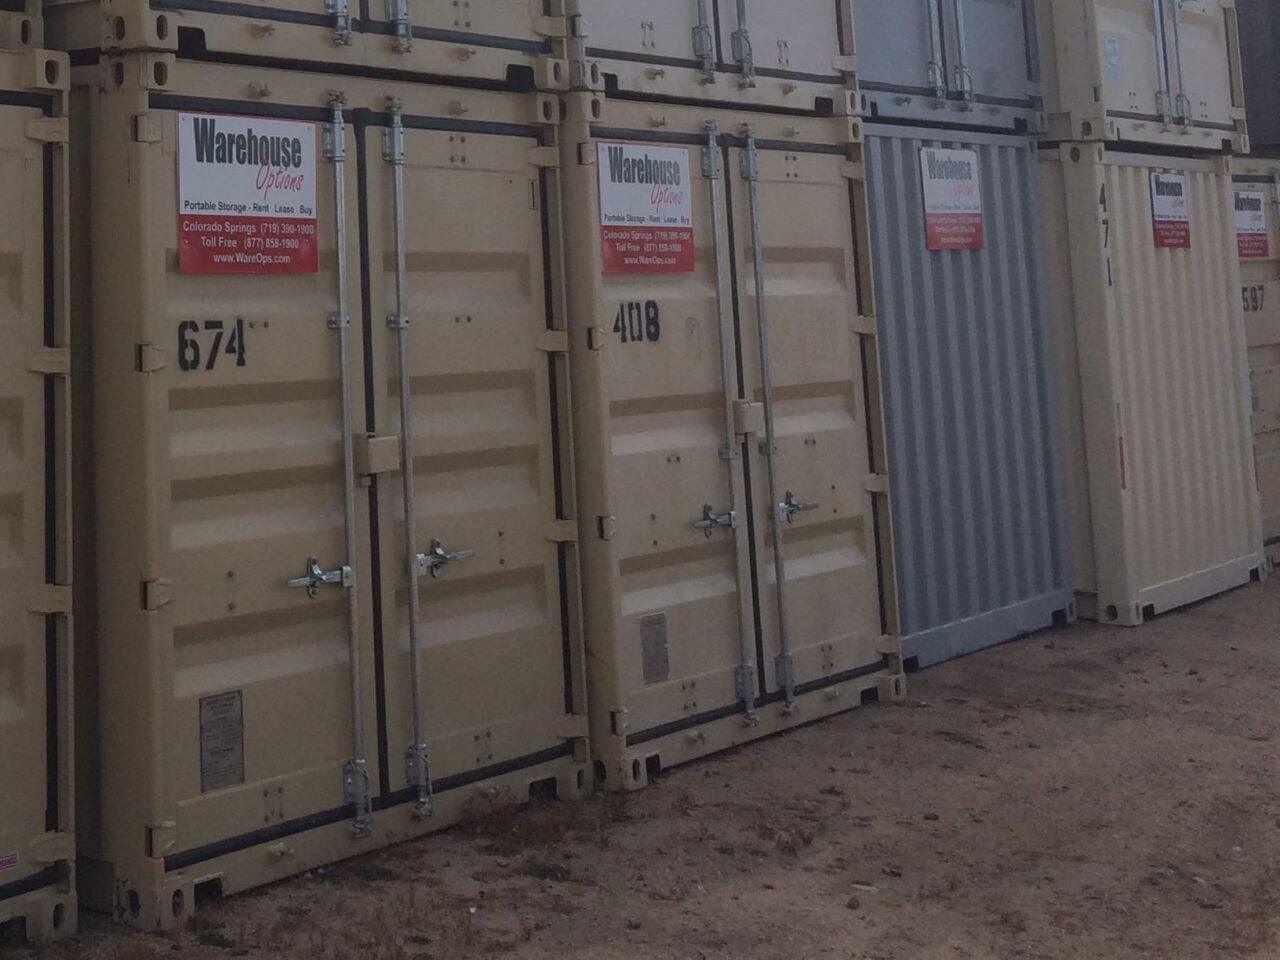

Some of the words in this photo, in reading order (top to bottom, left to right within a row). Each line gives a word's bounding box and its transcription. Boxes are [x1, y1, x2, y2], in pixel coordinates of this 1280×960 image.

[193, 117, 302, 168] Warehouse
[256, 162, 304, 200] Options
[608, 146, 681, 186] Warehouse
[184, 200, 216, 211] Portable
[218, 202, 246, 212] Storage
[253, 203, 269, 213] Rent
[275, 205, 295, 214] Lease
[300, 205, 313, 216] Buy
[183, 221, 222, 232] Colorado
[224, 222, 257, 235] Springs
[260, 223, 279, 235] (719)
[200, 236, 217, 247] Toll
[220, 237, 237, 248] Free
[244, 237, 264, 250] (877)
[214, 253, 291, 266] www.WareOps.com
[1242, 285, 1265, 312] 597
[613, 300, 660, 343] 408
[178, 318, 246, 371] 674
